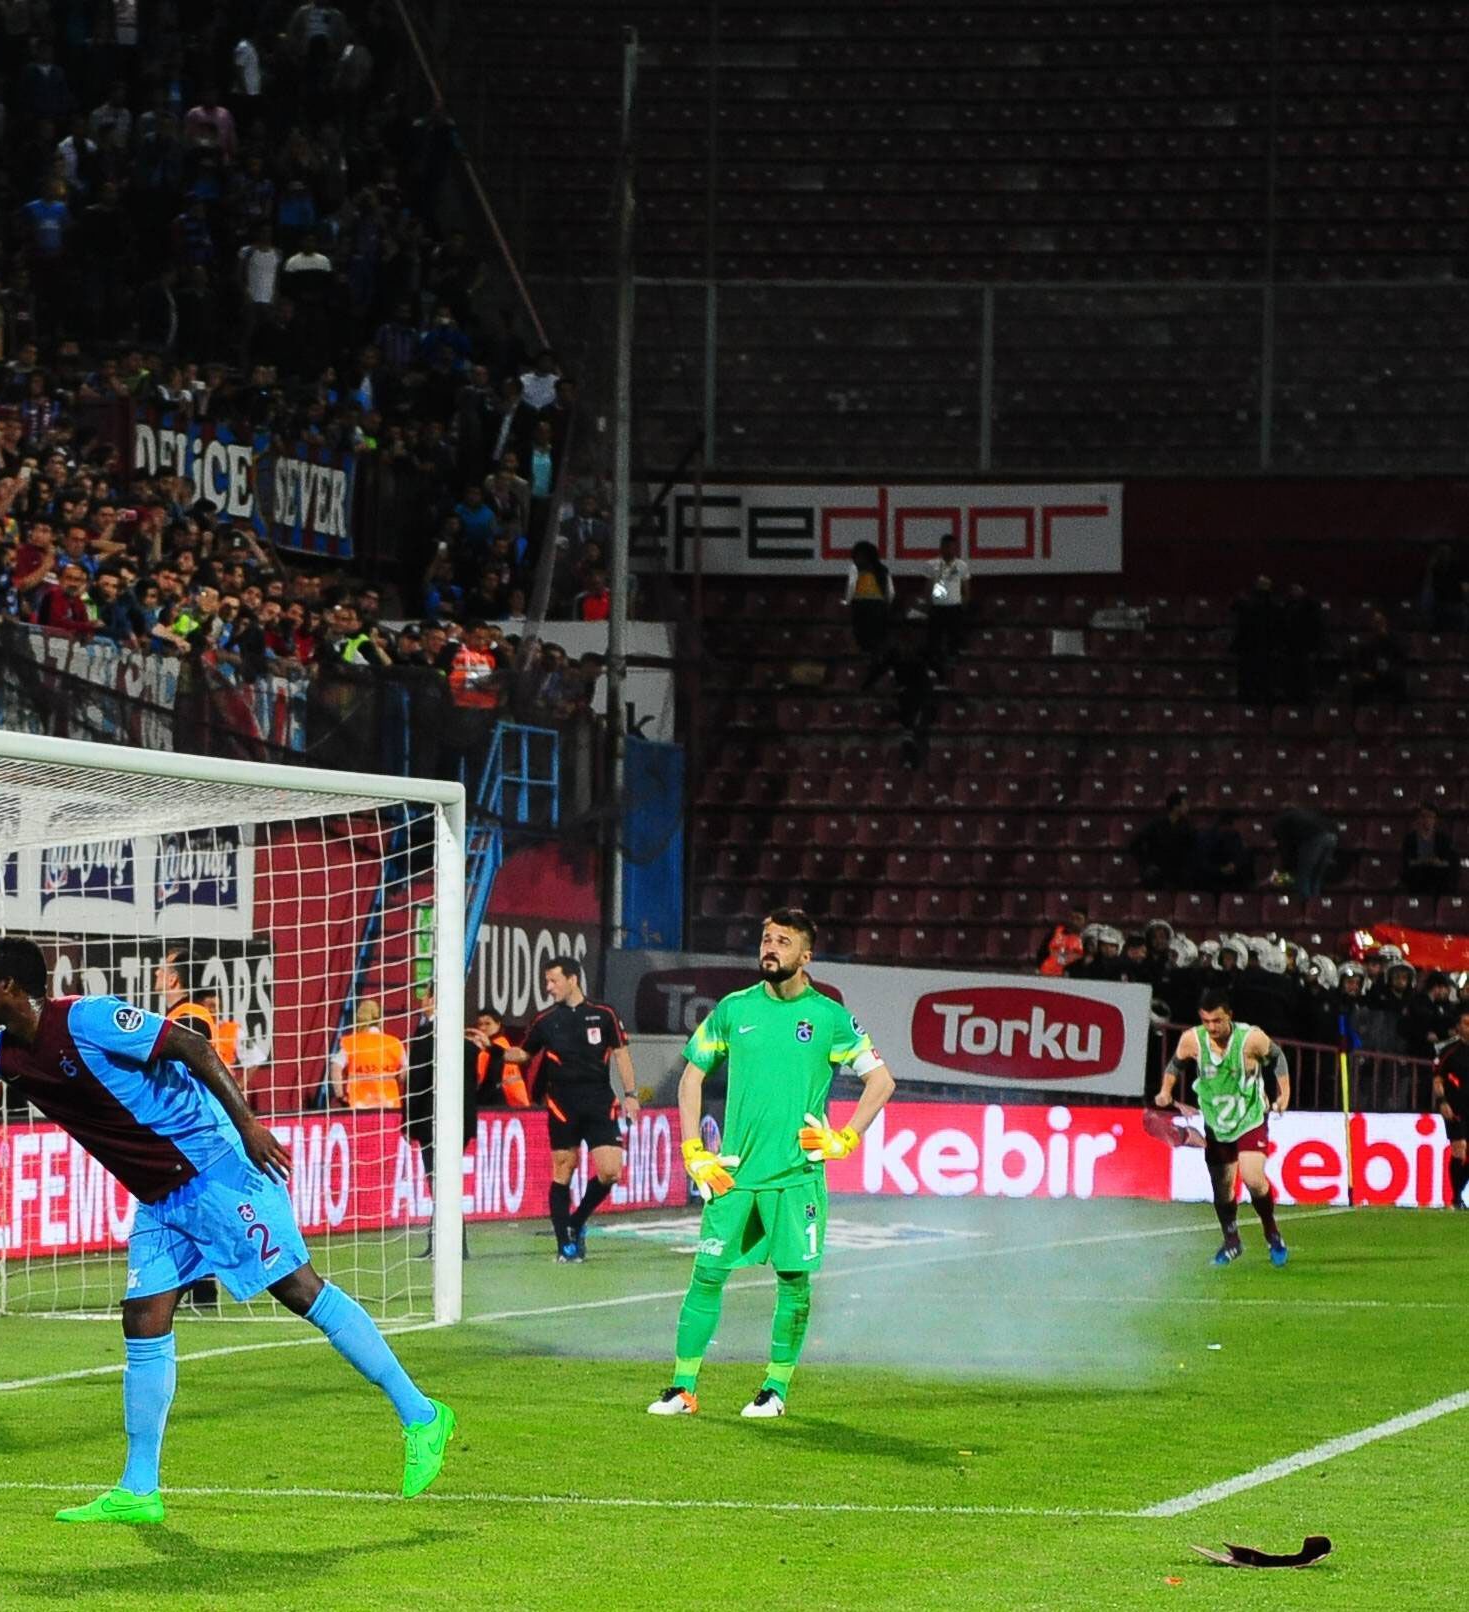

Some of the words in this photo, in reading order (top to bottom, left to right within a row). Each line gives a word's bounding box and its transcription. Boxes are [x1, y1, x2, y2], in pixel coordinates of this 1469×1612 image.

[275, 456, 348, 539] SEVER
[932, 1003, 1103, 1063] Torku
[862, 1104, 1119, 1199] kebir
[246, 1222, 282, 1263] 2
[805, 1222, 818, 1255] 1
